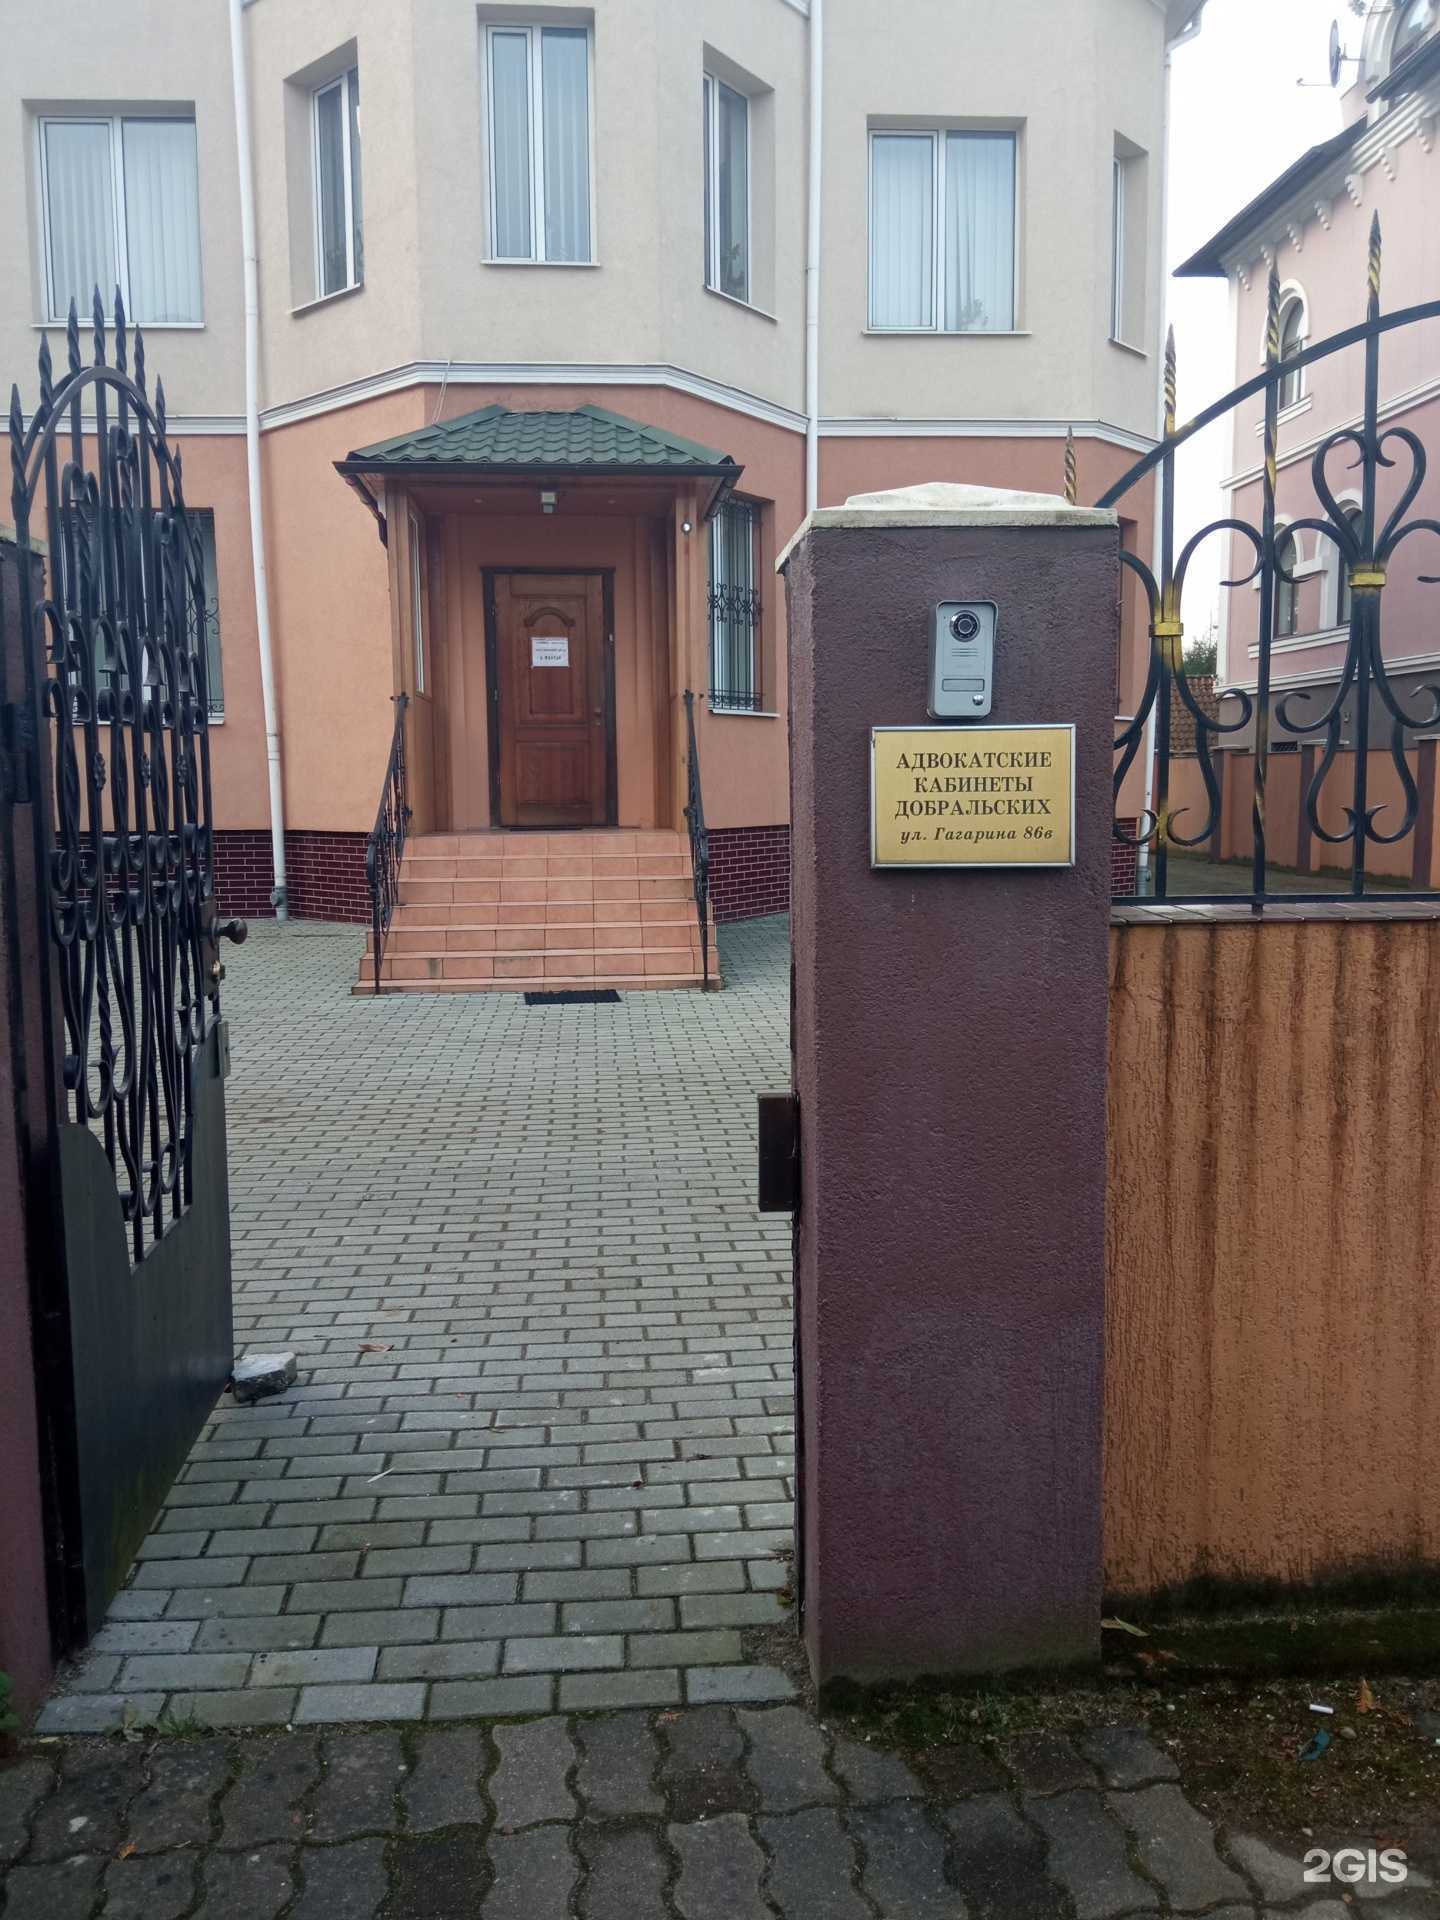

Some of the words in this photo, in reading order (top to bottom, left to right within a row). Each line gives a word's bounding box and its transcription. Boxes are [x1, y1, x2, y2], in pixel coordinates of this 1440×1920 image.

[896, 751, 1053, 772] АДВОКАТСКИЕ
[914, 776, 1033, 793] КАБИНЕТЫ
[894, 798, 1052, 819] ДОБРАЛЬСКИХ
[900, 830, 927, 844] ул.
[934, 827, 1017, 843] Гагарина
[1023, 826, 1054, 840] 86в
